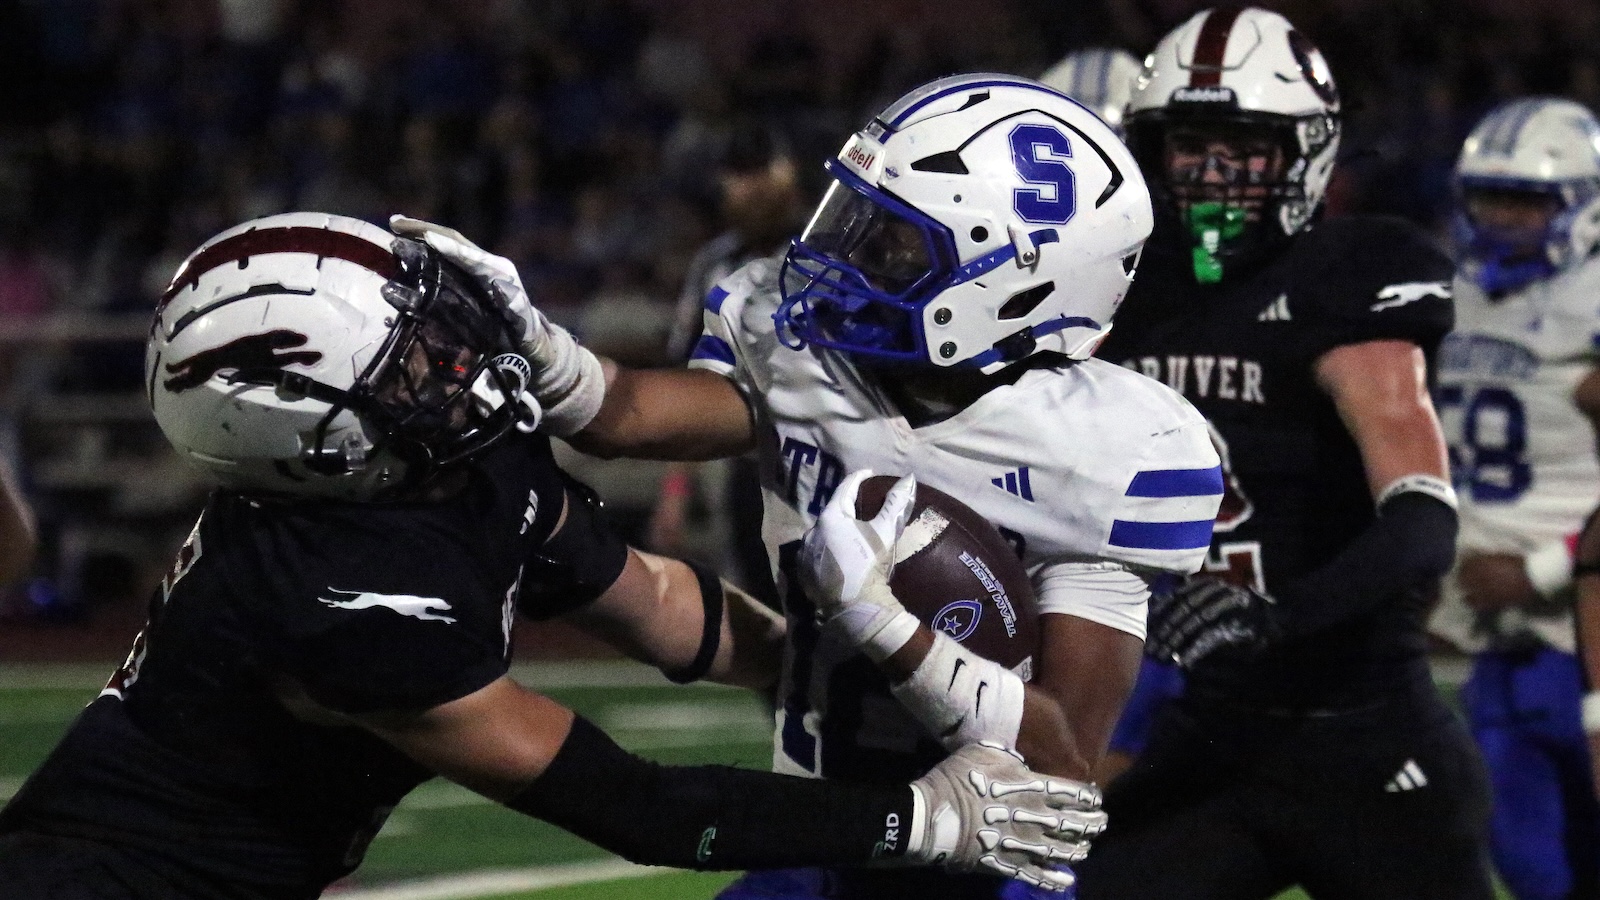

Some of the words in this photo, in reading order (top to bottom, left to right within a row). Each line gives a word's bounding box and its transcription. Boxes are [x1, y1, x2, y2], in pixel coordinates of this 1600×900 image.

[846, 144, 875, 171] ddell
[1008, 124, 1076, 225] S
[1120, 355, 1266, 405] RUVER
[958, 550, 997, 593] ISSUE
[992, 593, 1017, 638] TEAM
